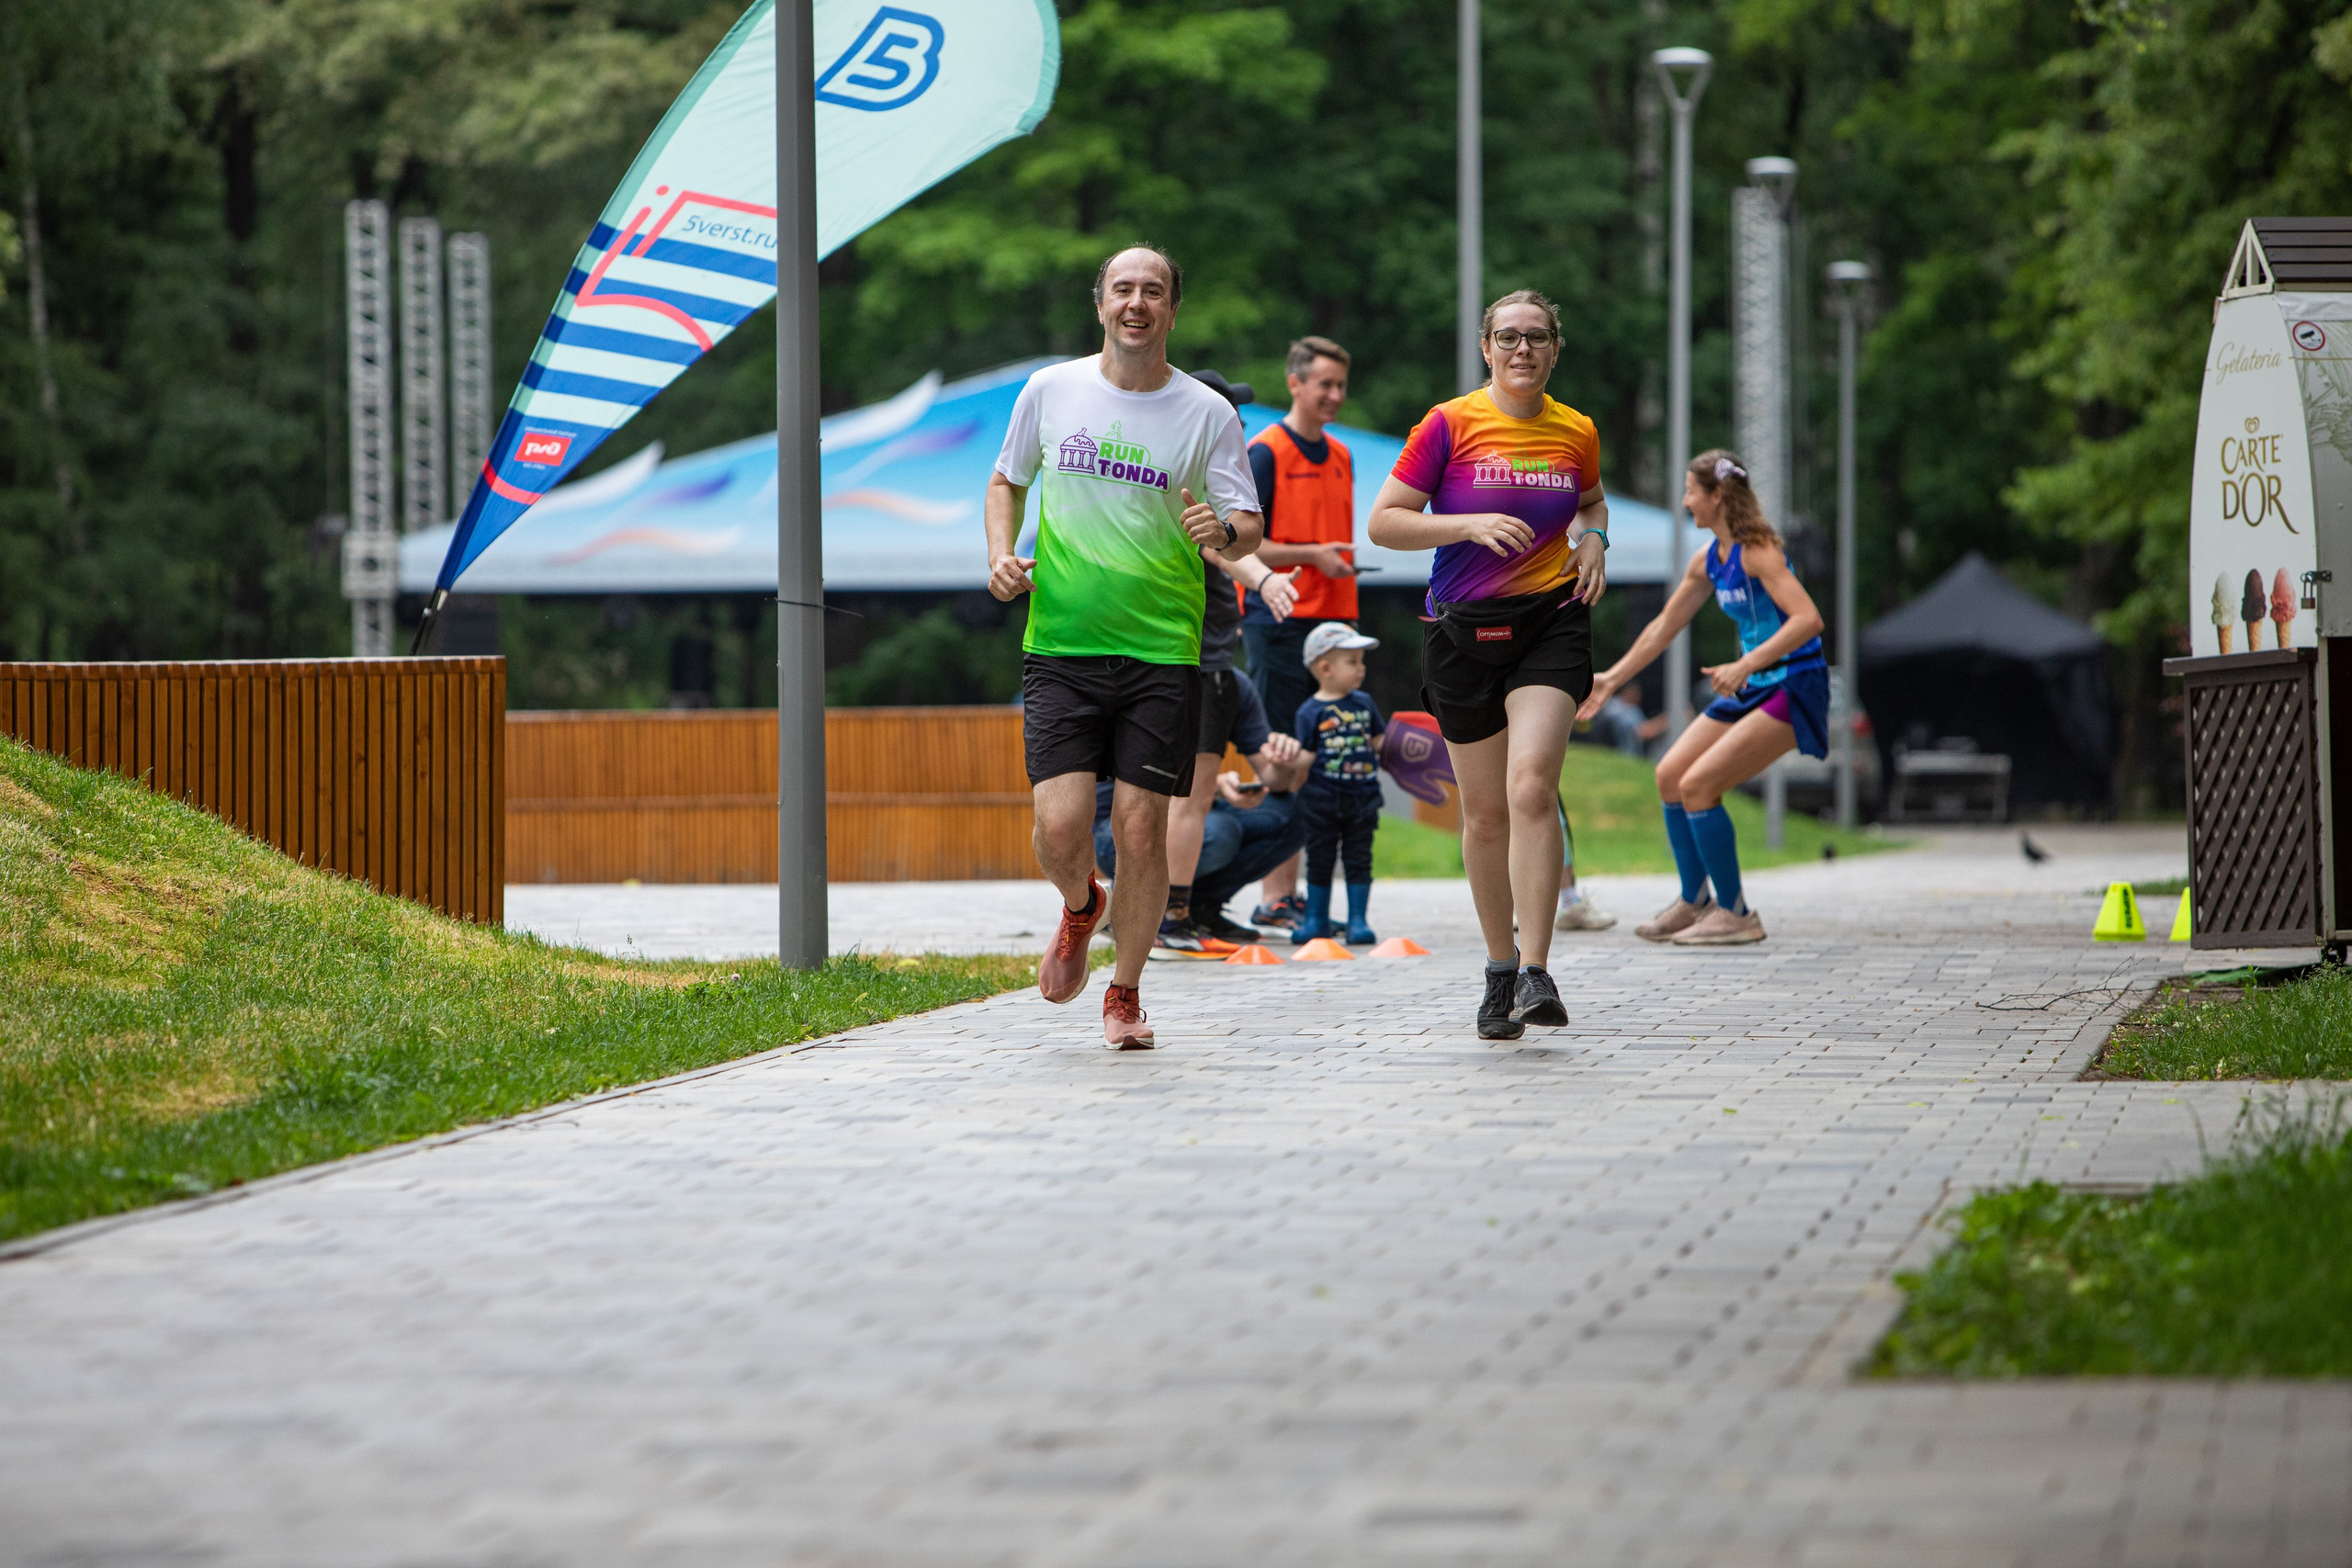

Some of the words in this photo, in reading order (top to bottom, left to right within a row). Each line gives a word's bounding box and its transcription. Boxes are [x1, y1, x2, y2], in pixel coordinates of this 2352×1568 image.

[682, 214, 777, 250] 5verst.ru
[2215, 341, 2282, 386] Gelateria
[1099, 441, 1145, 465] RUN
[1511, 458, 1549, 473] RUN
[2221, 434, 2282, 475] CARTE
[1098, 458, 1169, 491] TONDA
[1512, 471, 1574, 490] TONDA
[2222, 471, 2301, 535] D'OR
